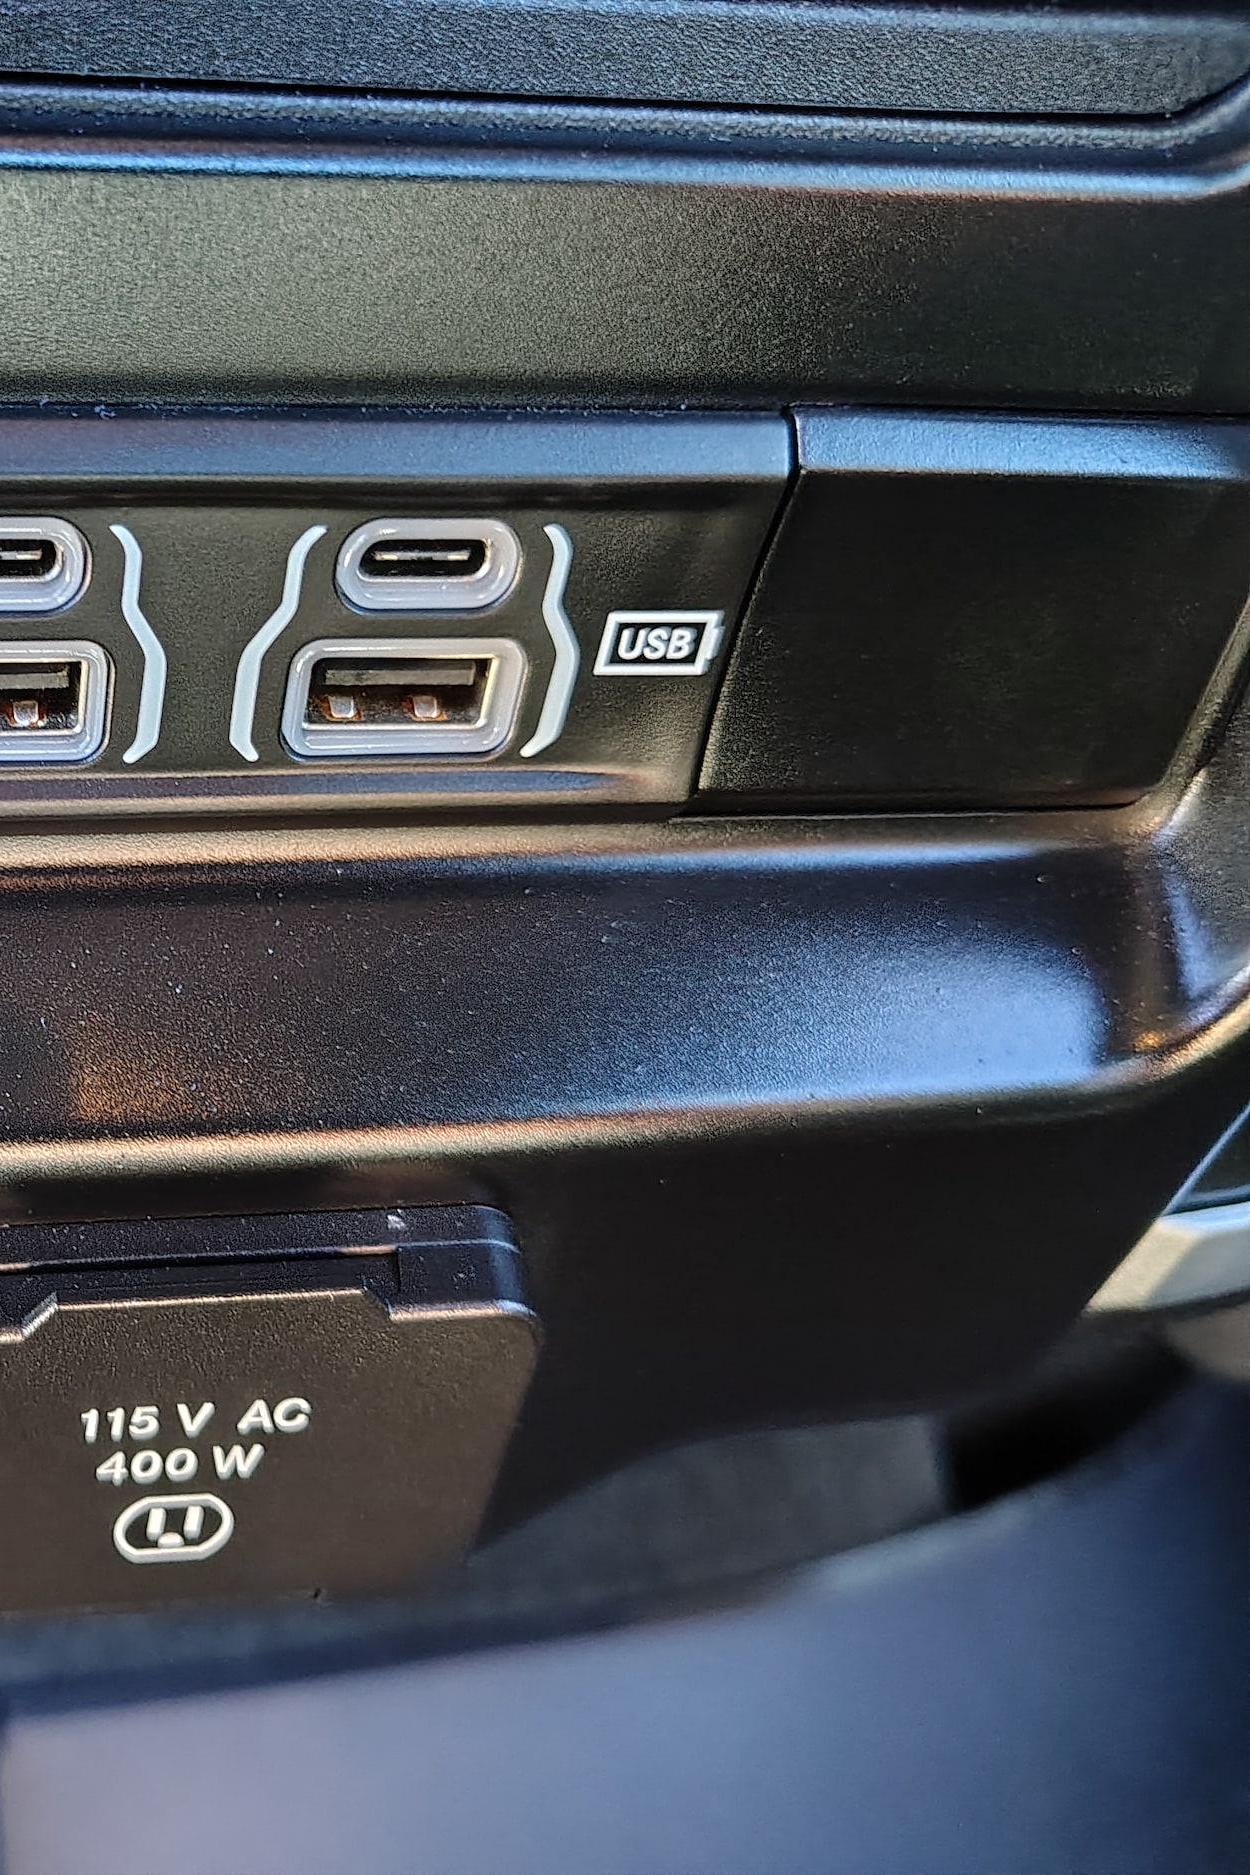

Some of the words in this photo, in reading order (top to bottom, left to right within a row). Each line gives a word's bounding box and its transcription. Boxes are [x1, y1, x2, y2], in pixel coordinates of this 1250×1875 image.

[617, 626, 699, 660] USB
[80, 1405, 161, 1443] 115
[176, 1401, 215, 1438] V
[236, 1397, 312, 1435] AC
[95, 1447, 199, 1486] 400
[212, 1443, 265, 1480] W
